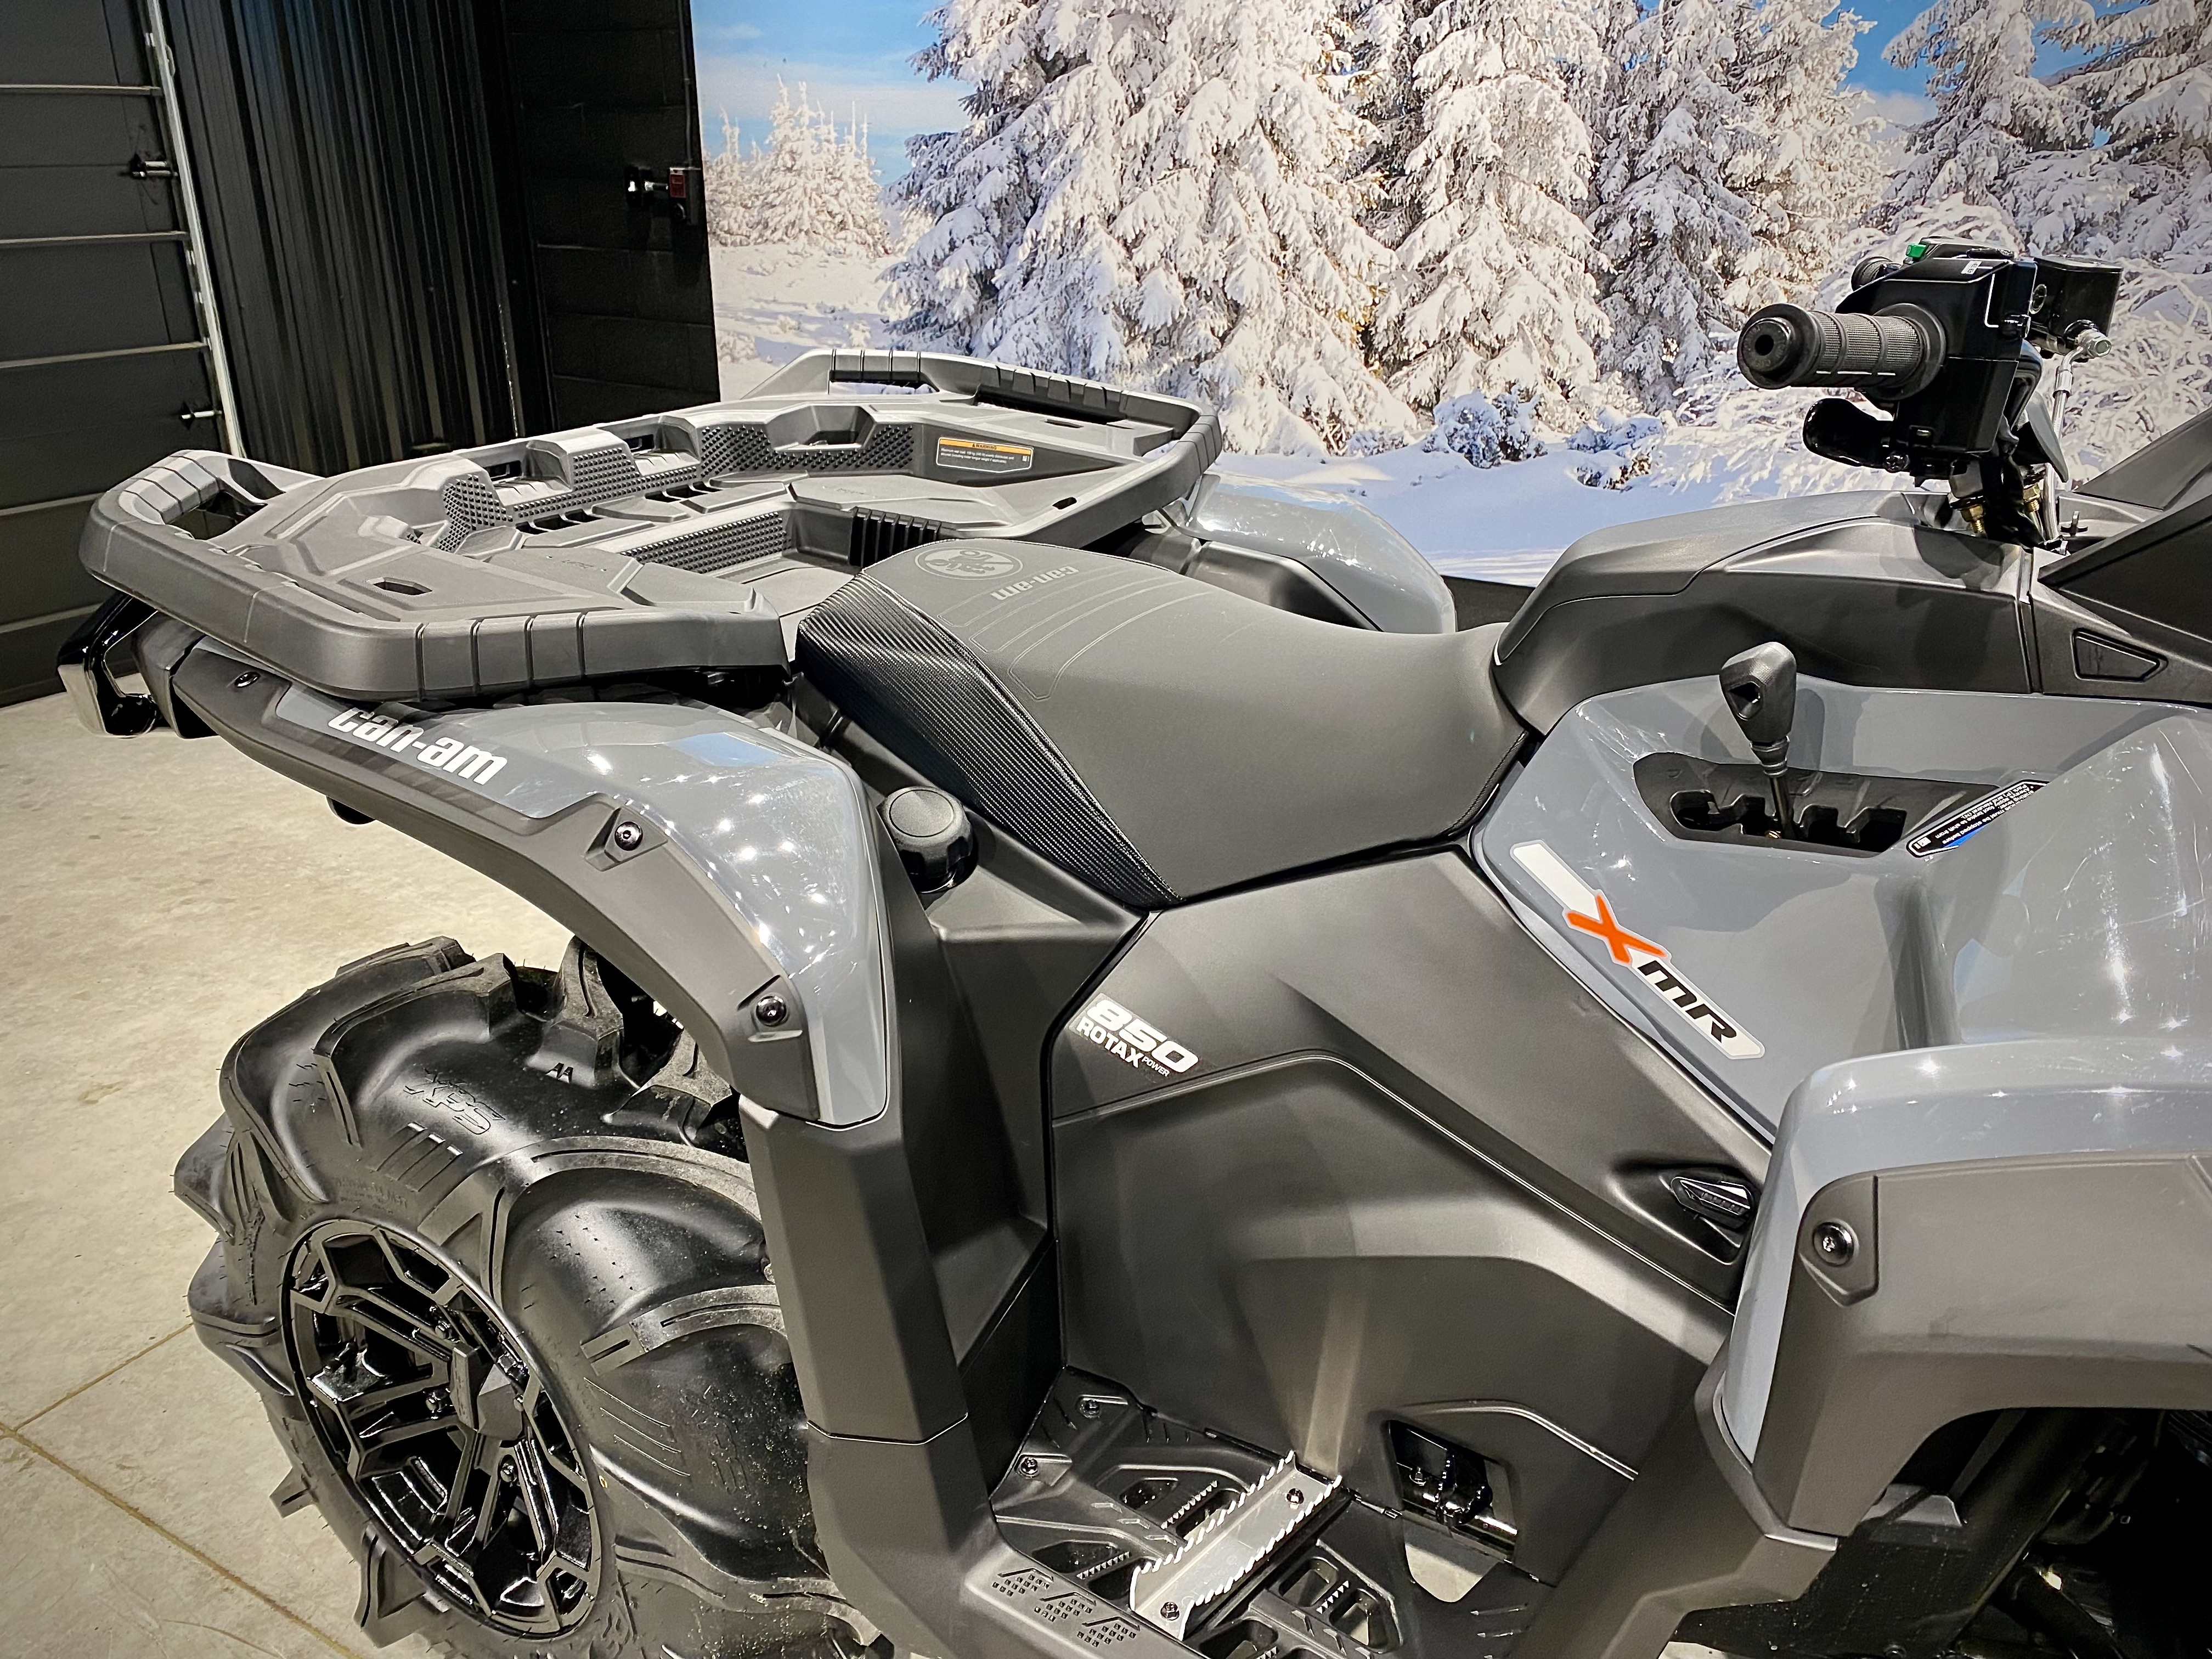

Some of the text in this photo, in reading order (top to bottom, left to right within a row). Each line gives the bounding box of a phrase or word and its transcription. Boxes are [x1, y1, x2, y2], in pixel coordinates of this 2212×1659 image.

[990, 566, 1079, 600] can-am
[328, 707, 508, 786] can-am
[1076, 1016, 1170, 1077] ROTAX POWER
[1087, 1000, 1199, 1073] 850
